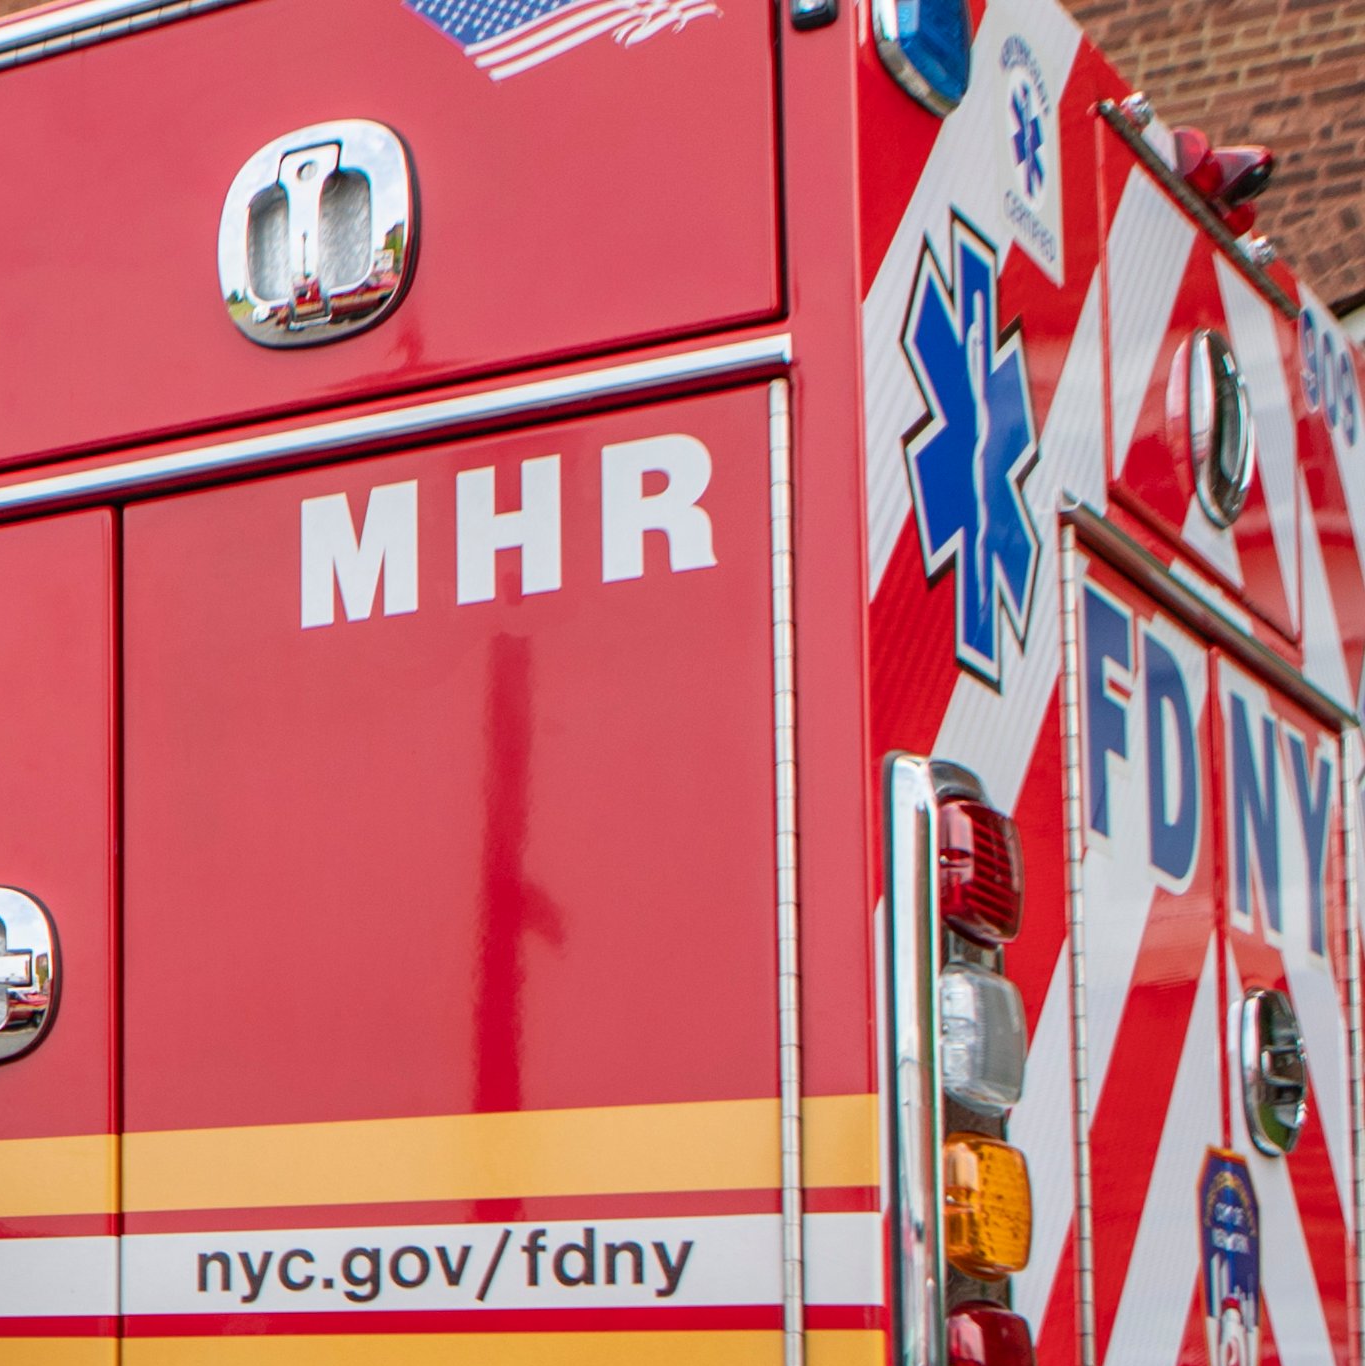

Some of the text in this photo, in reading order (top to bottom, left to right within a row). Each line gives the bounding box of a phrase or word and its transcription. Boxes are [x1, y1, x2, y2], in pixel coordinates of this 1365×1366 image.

[301, 433, 718, 630] MHR
[1082, 575, 1334, 963] FDNY
[196, 1227, 694, 1303] nyc.gov/fdny
